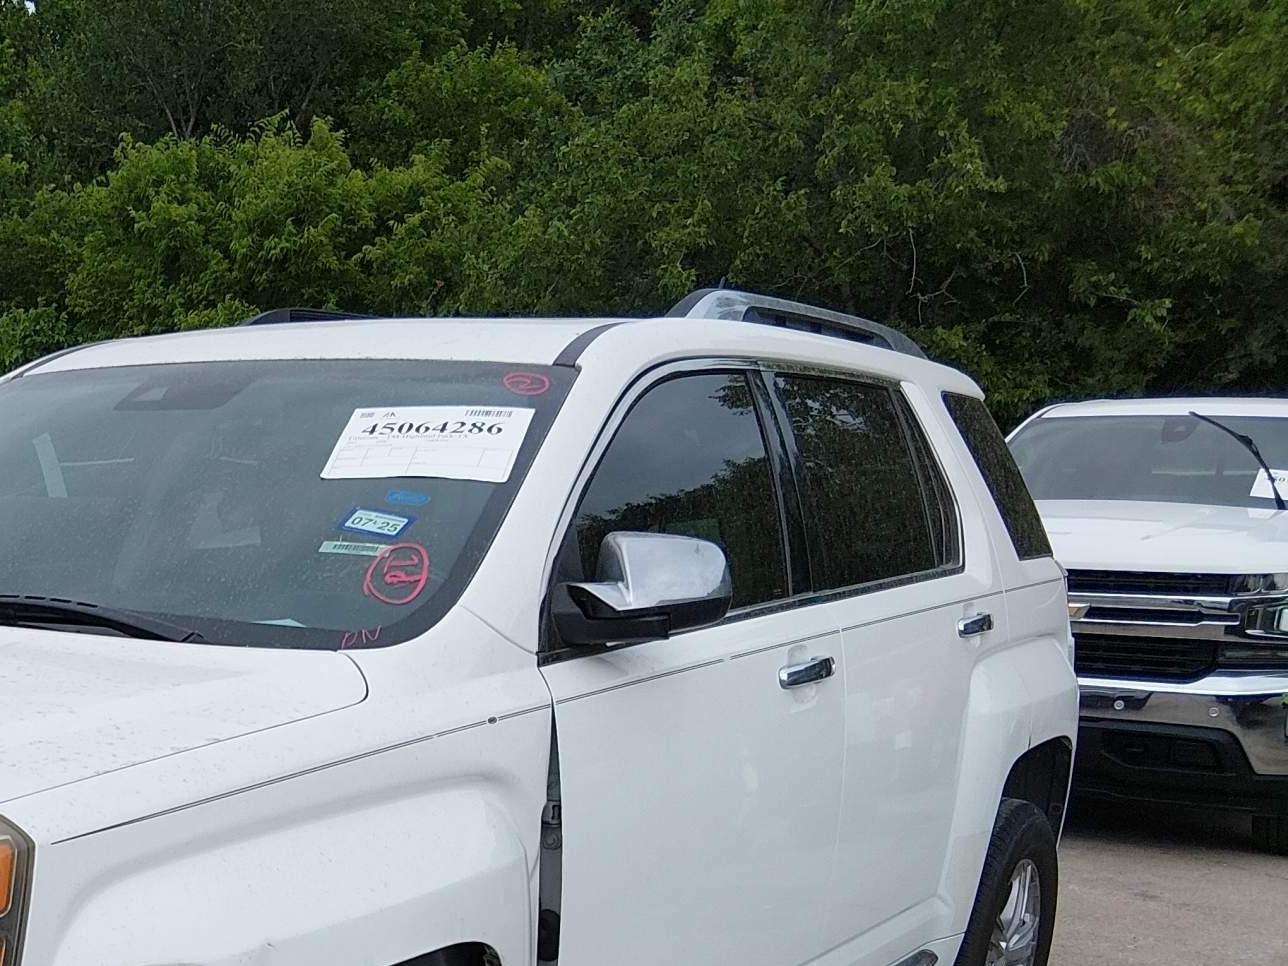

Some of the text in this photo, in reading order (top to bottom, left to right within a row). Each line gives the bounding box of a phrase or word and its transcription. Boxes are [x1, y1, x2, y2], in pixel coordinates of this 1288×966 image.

[361, 420, 505, 436] 45064286
[351, 515, 374, 528] 07
[376, 521, 401, 534] 25
